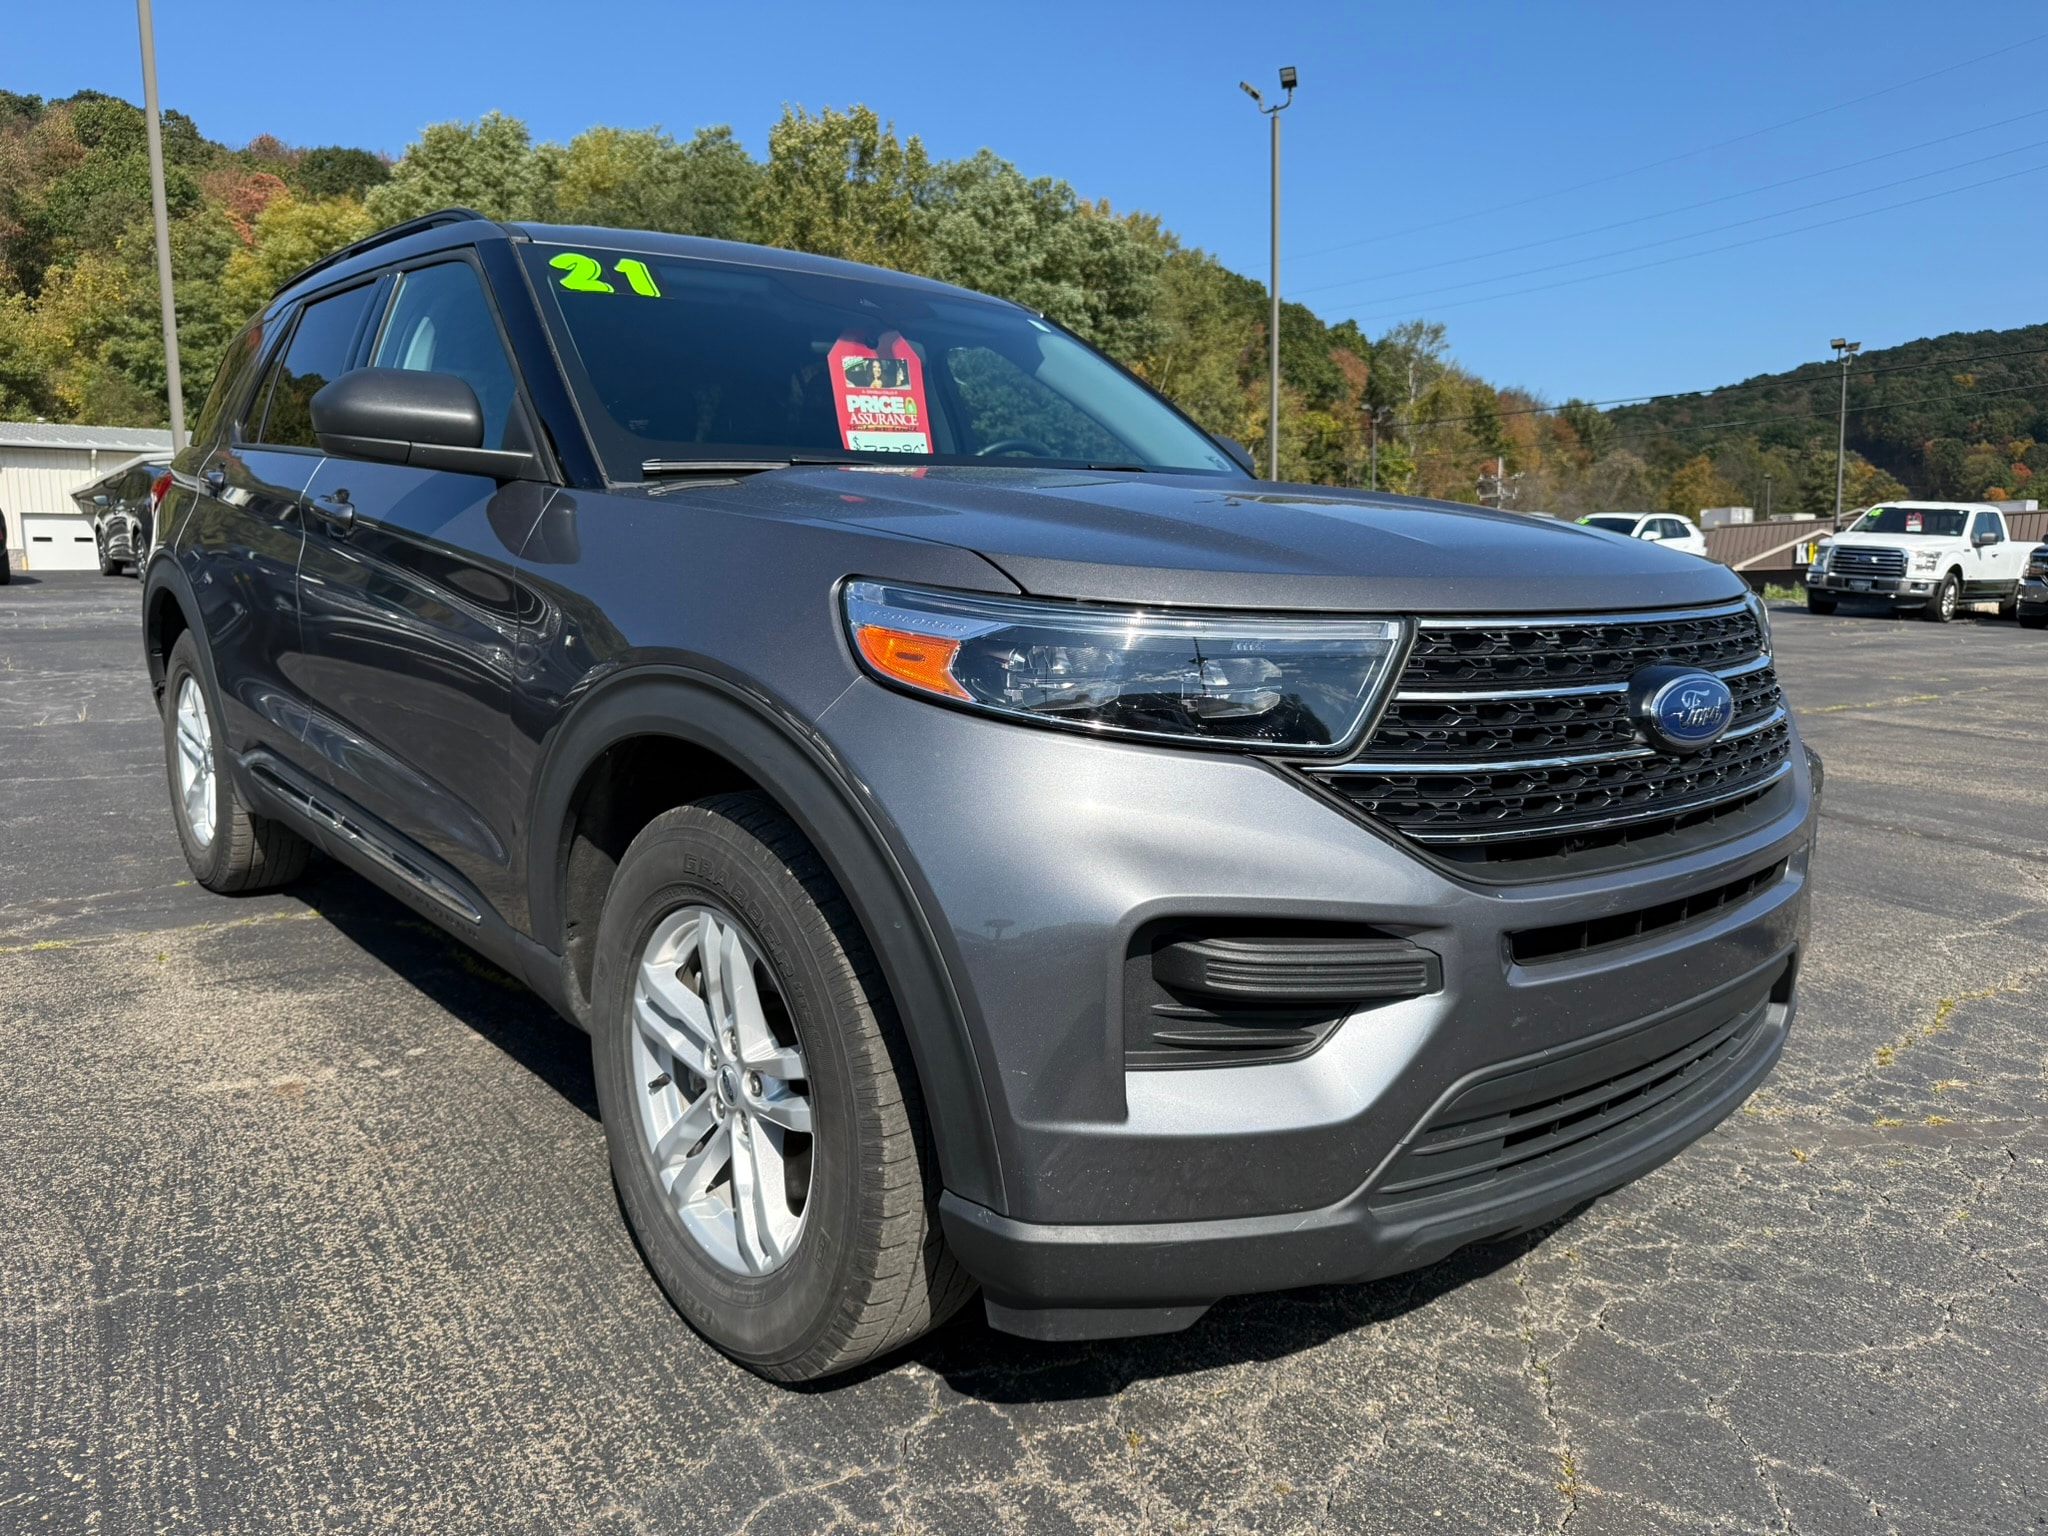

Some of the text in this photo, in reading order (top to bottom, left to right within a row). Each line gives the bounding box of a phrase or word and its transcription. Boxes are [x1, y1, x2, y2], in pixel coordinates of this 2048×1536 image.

[846, 395, 905, 414] PRICE
[850, 413, 919, 426] ASSURANCE
[1672, 689, 1724, 729] Ford
